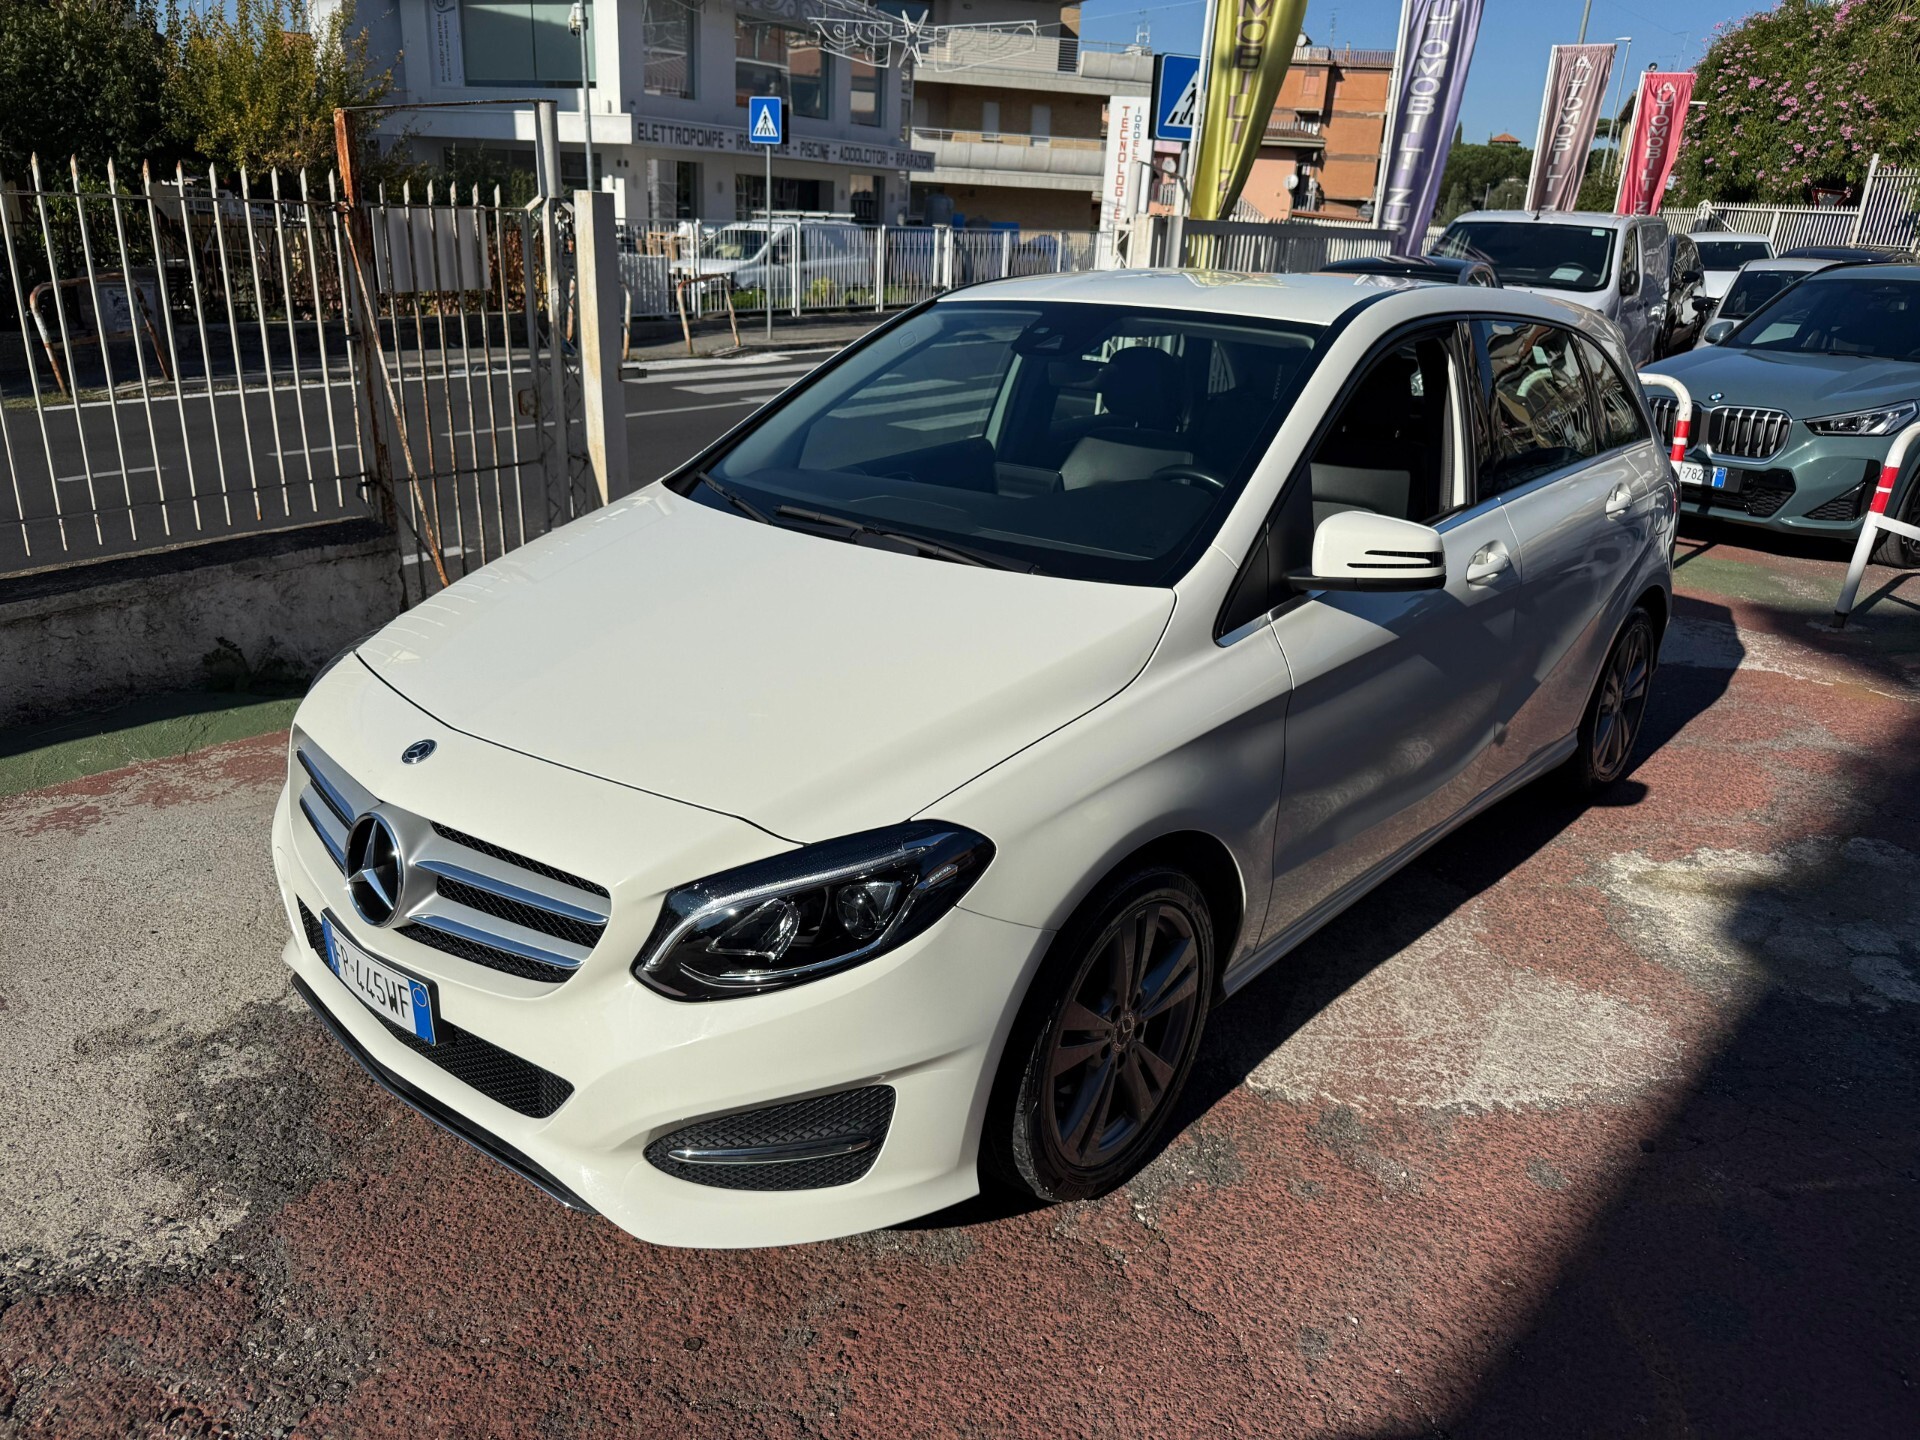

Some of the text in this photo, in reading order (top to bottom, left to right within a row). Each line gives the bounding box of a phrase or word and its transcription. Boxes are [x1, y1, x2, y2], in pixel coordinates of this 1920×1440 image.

[637, 122, 724, 149] ELETTROPOMPE
[799, 141, 830, 161] PISCINE
[839, 145, 888, 166] ADDOLCITORI
[1113, 105, 1131, 220] TECNOLOGIE
[1546, 54, 1593, 192] AUTOMOBILI
[1641, 81, 1676, 191] AUTOMOBILI
